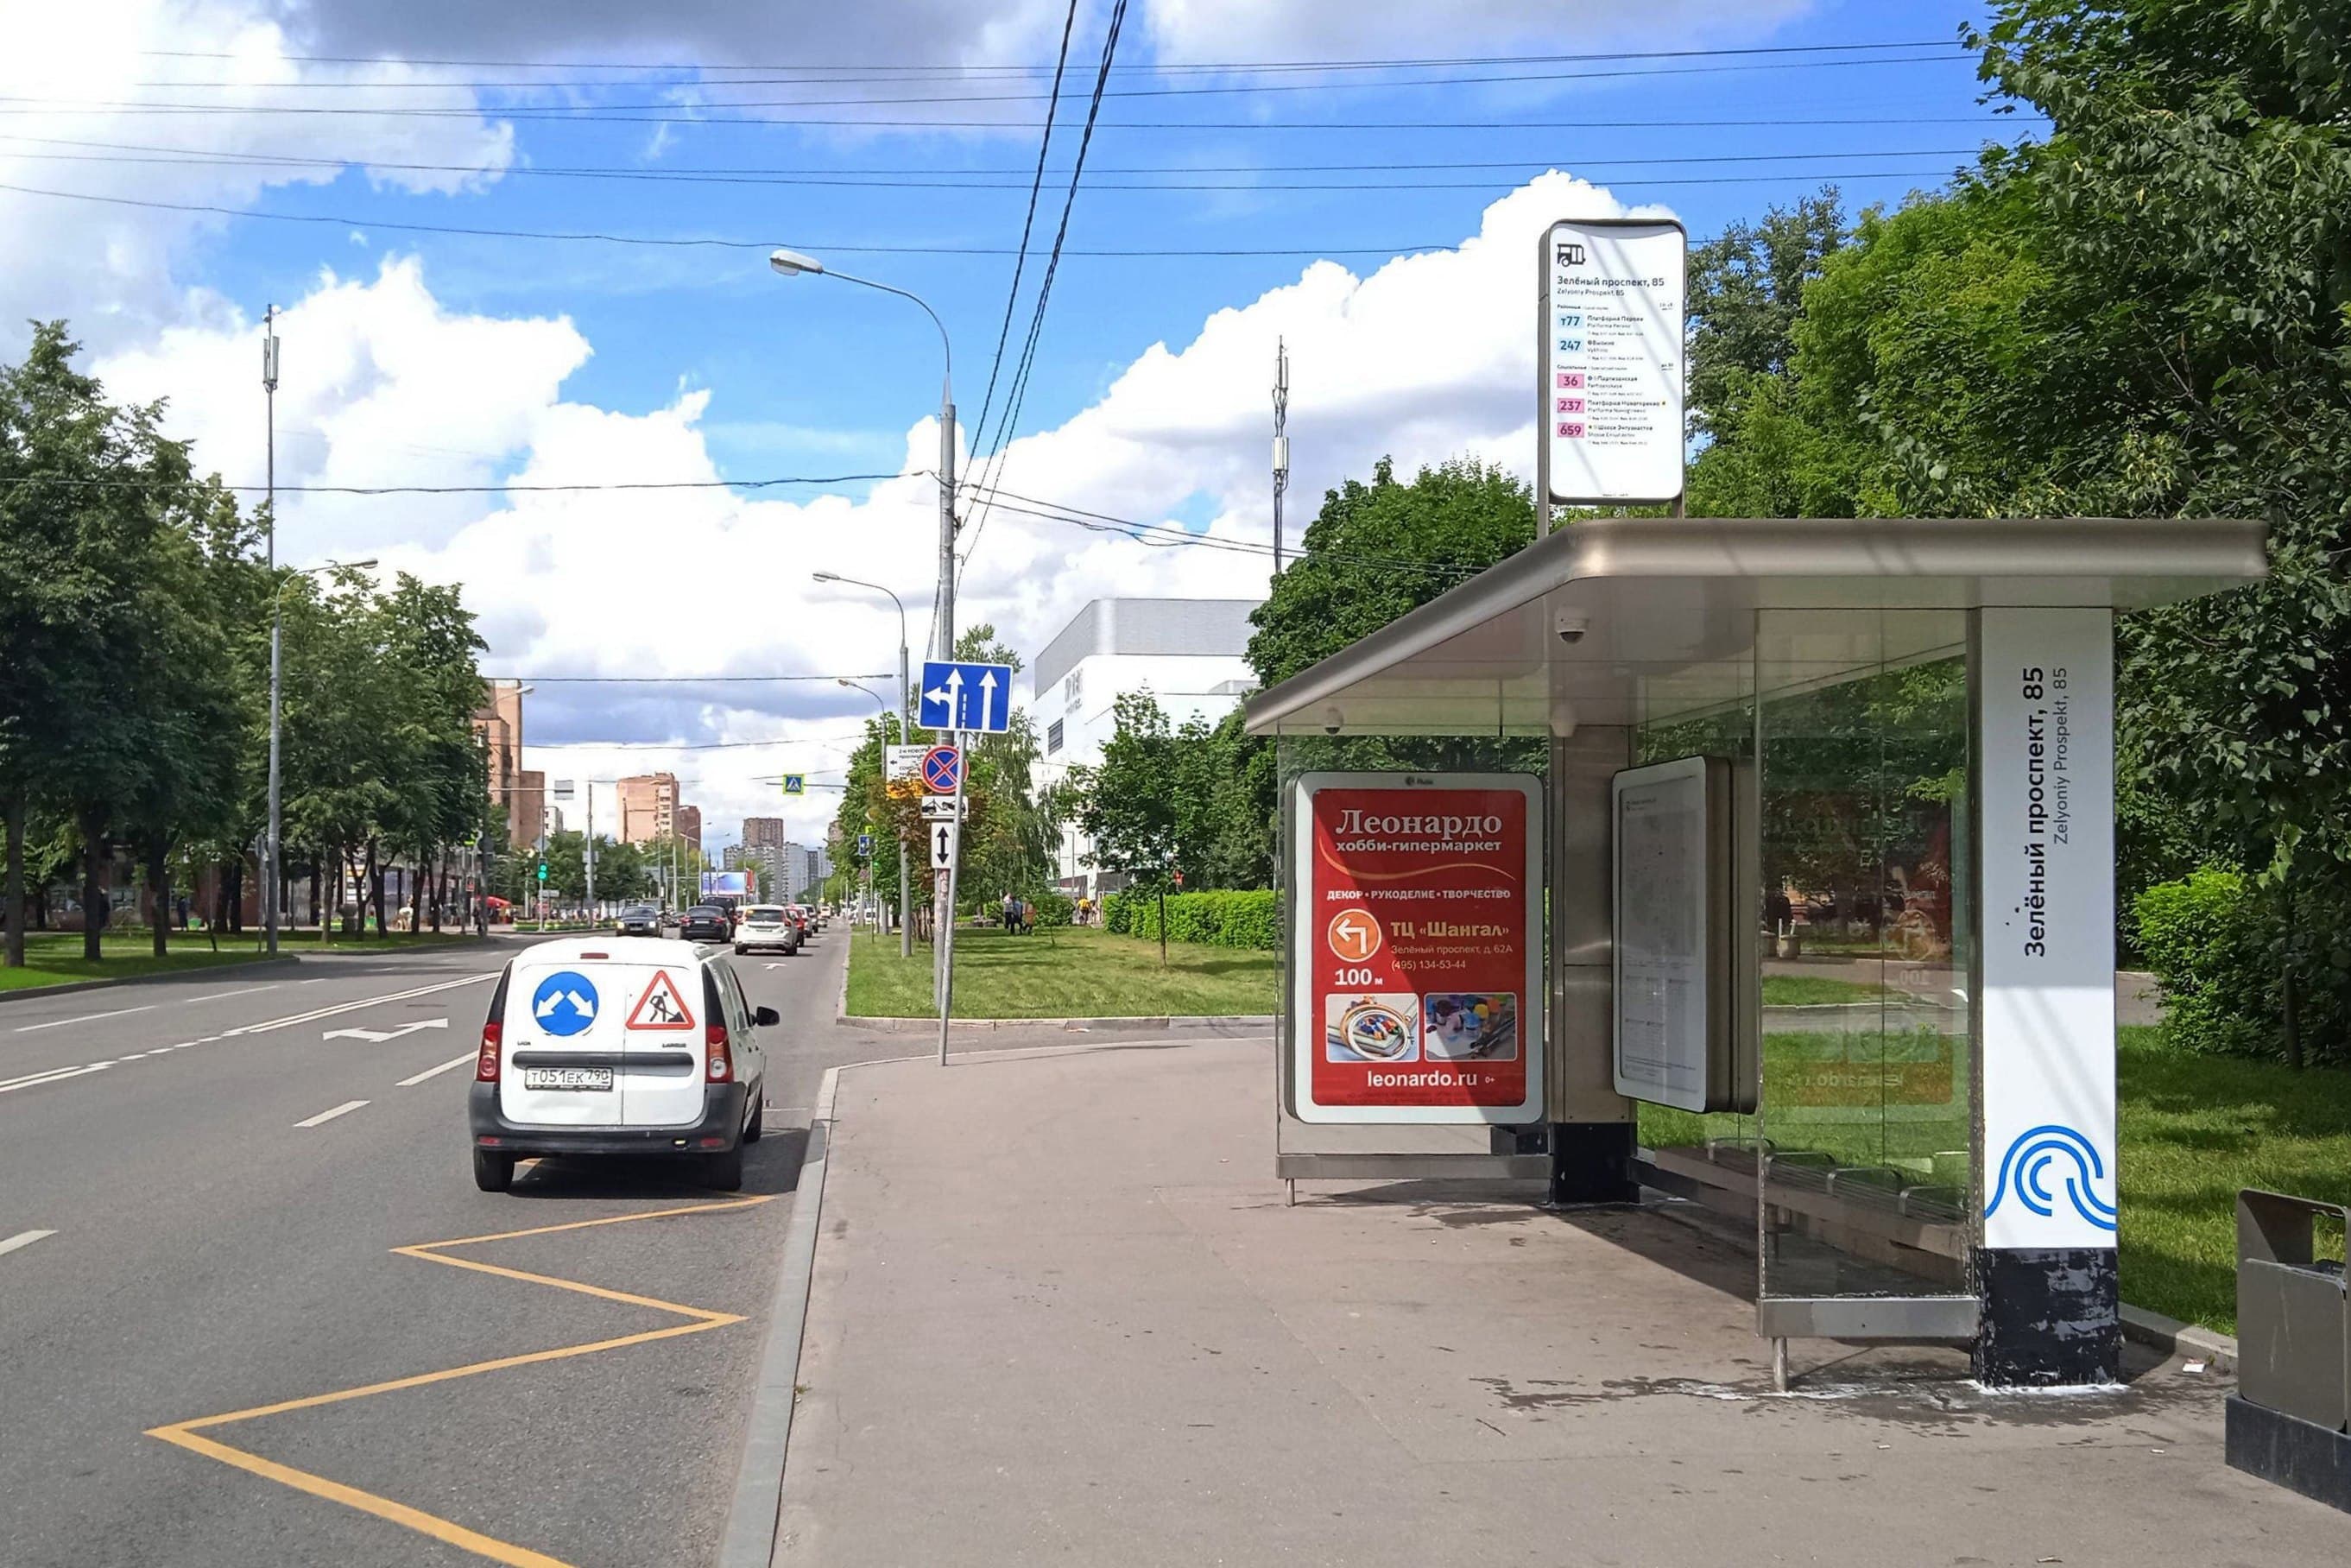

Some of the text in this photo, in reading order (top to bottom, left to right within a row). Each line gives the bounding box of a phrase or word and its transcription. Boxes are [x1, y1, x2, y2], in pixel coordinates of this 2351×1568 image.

[1557, 275, 1665, 288] Зелёный проспект, 85
[1560, 340, 1581, 351] 247
[1564, 376, 1578, 387] 36
[1560, 401, 1581, 411] 237
[1560, 425, 1582, 436] 659
[2053, 667, 2071, 845] Zelyoniy Prospekt, 85
[2023, 667, 2049, 958] Зелёный проспект, 85
[1336, 810, 1502, 840] Леонардо
[1337, 839, 1501, 854] хобби-гипермаркет
[1327, 889, 1511, 901] ДЕКОР РУКОДЕЛИЕ ТВОРЧЕСТВО
[1390, 921, 1509, 939] ТЦ «Шангал»
[1391, 945, 1435, 955] Зелёный
[1391, 960, 1466, 971] (495) 134-53-44
[1334, 969, 1373, 986] 100
[1367, 1071, 1477, 1087] leonardo.ru
